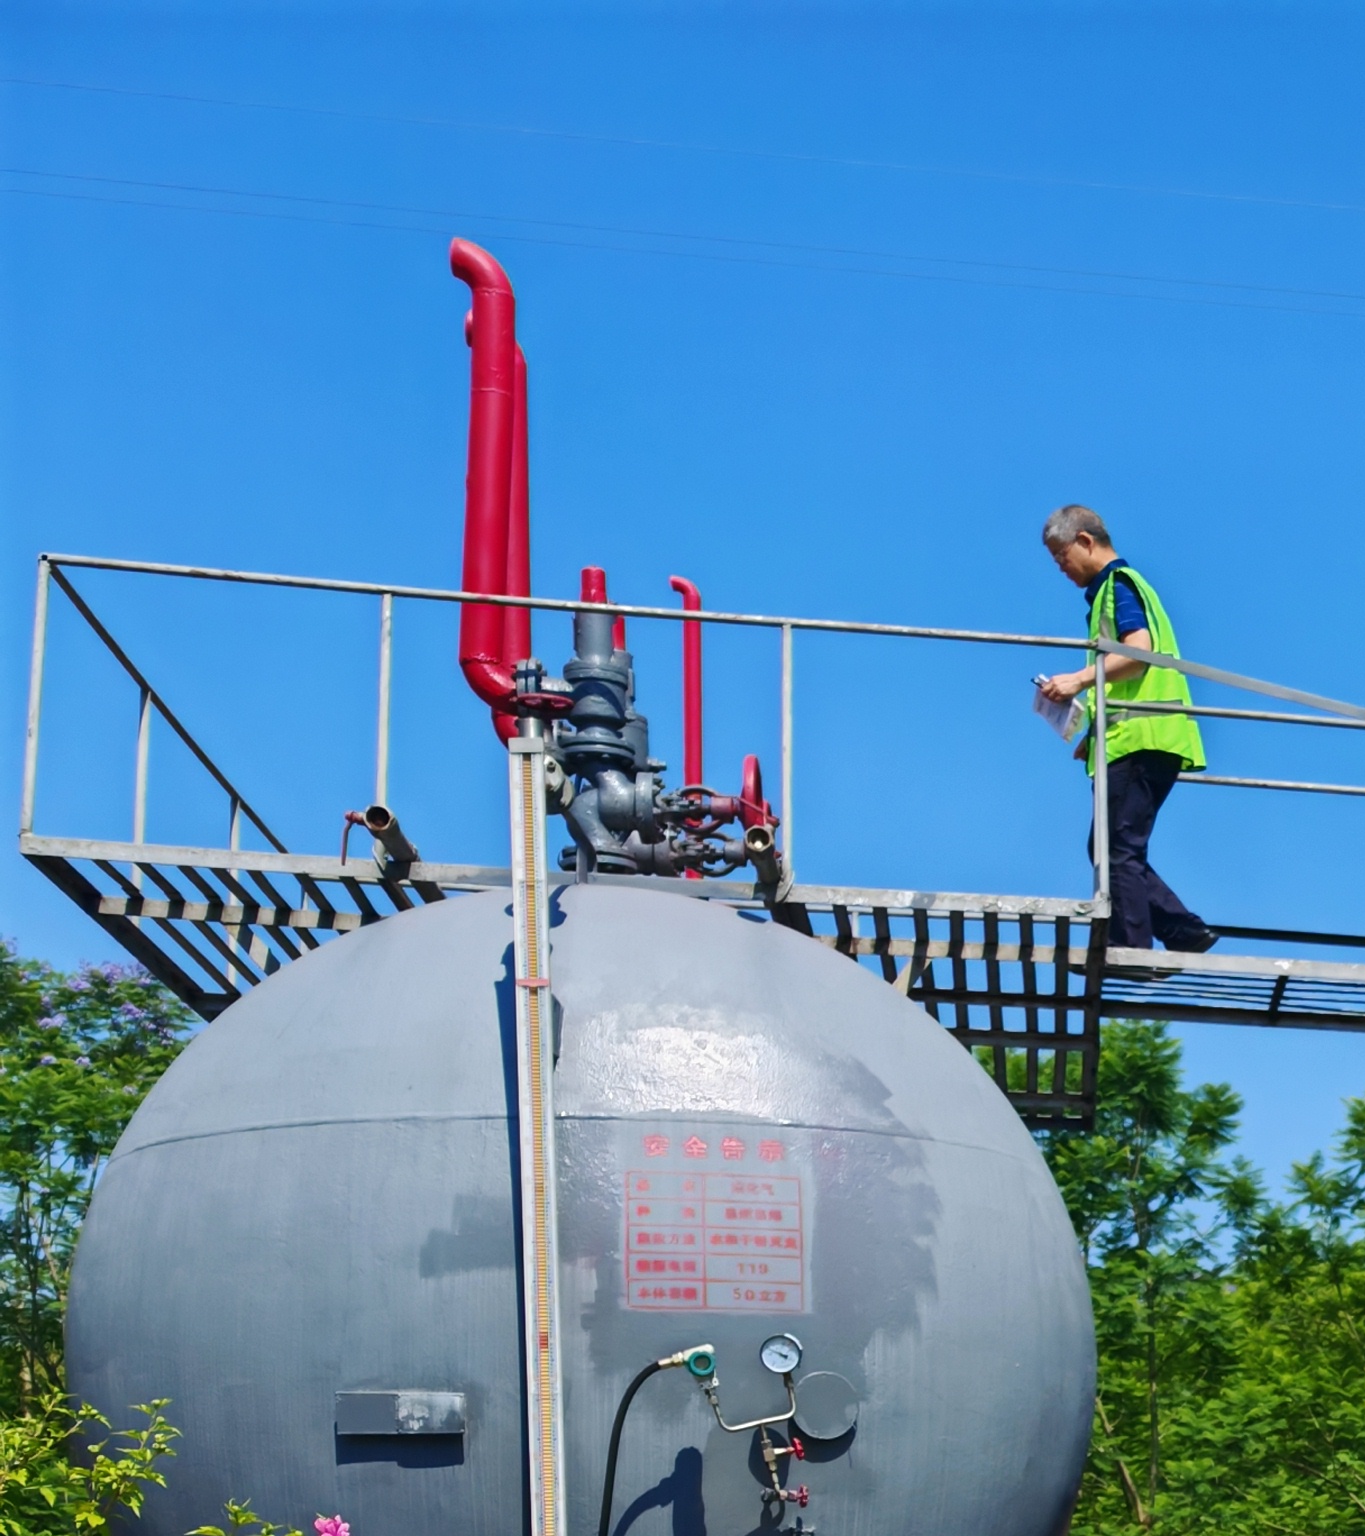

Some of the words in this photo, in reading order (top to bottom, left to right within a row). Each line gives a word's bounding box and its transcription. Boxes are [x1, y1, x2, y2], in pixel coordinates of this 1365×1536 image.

[643, 1134, 782, 1164] 安全告示
[737, 1262, 768, 1275] 119
